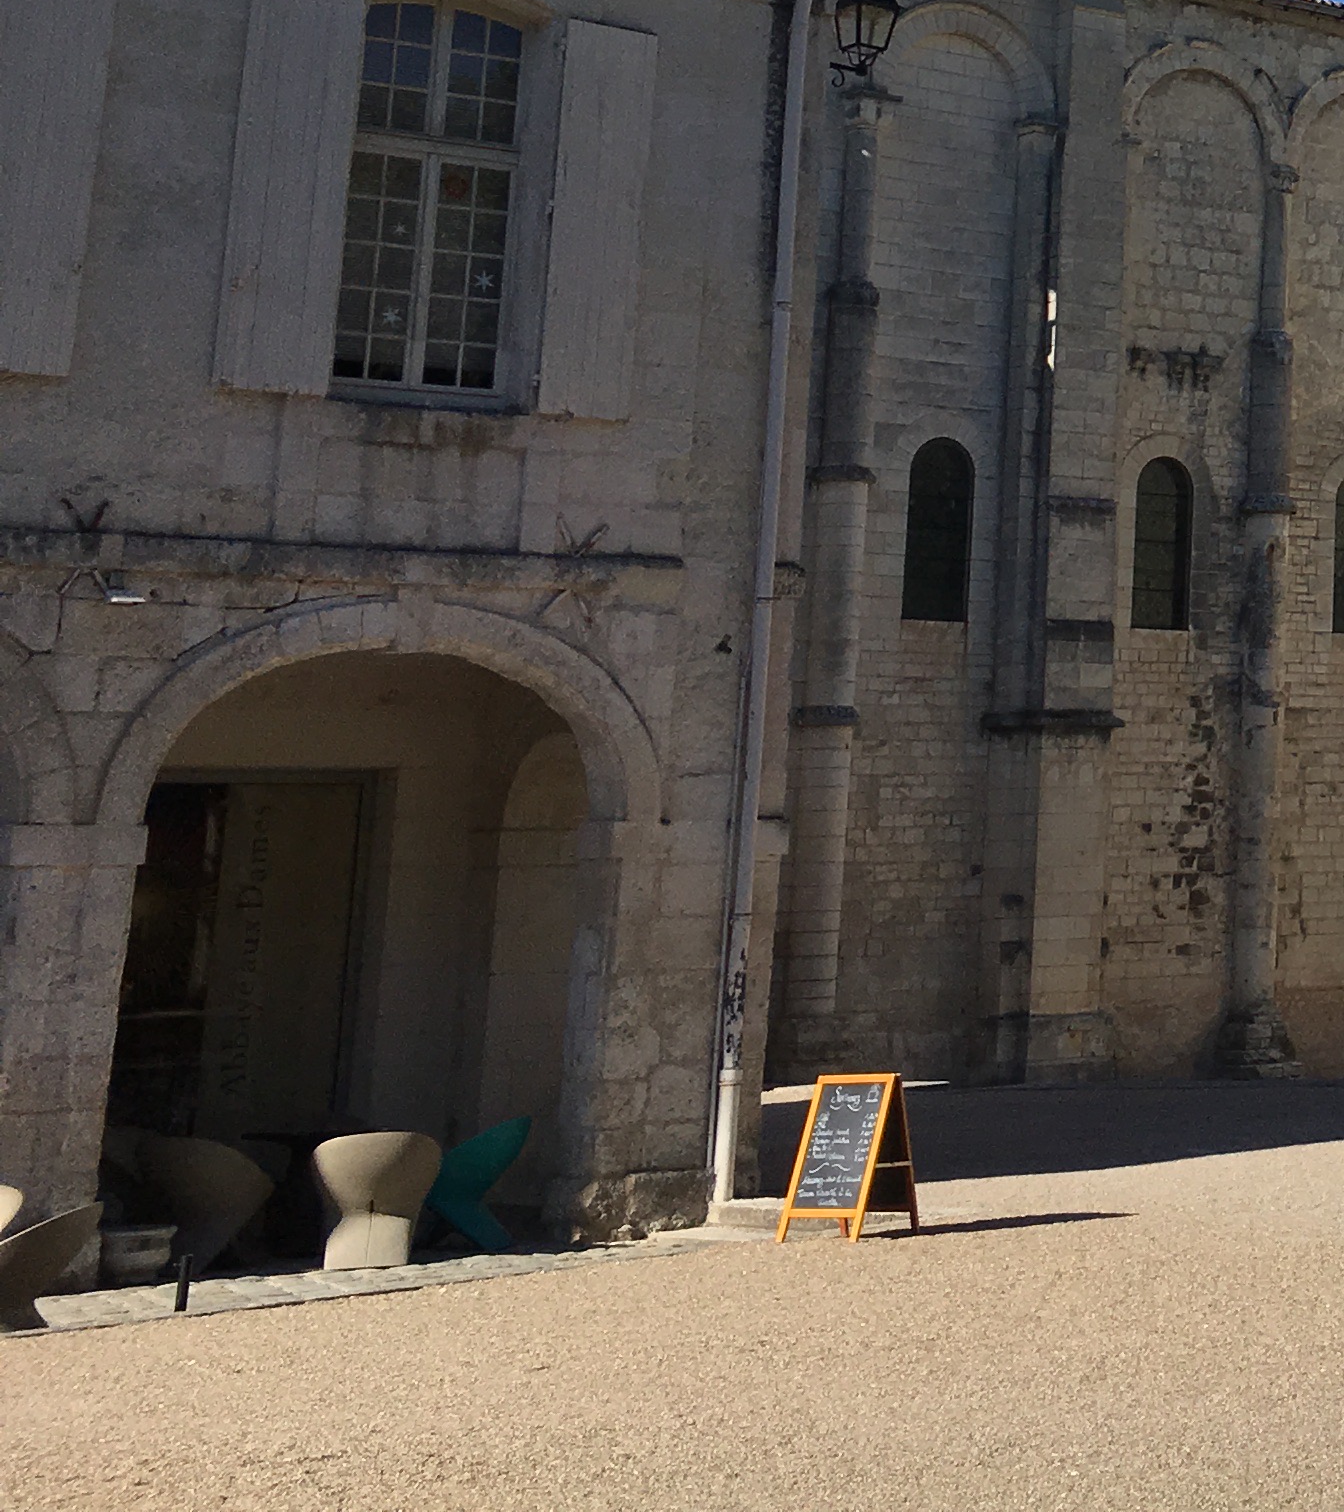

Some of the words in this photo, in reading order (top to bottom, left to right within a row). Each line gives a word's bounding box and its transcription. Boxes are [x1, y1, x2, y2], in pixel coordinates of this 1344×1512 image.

[235, 806, 272, 909] Dames
[242, 920, 263, 971] aux
[220, 978, 263, 1097] Abbaye
